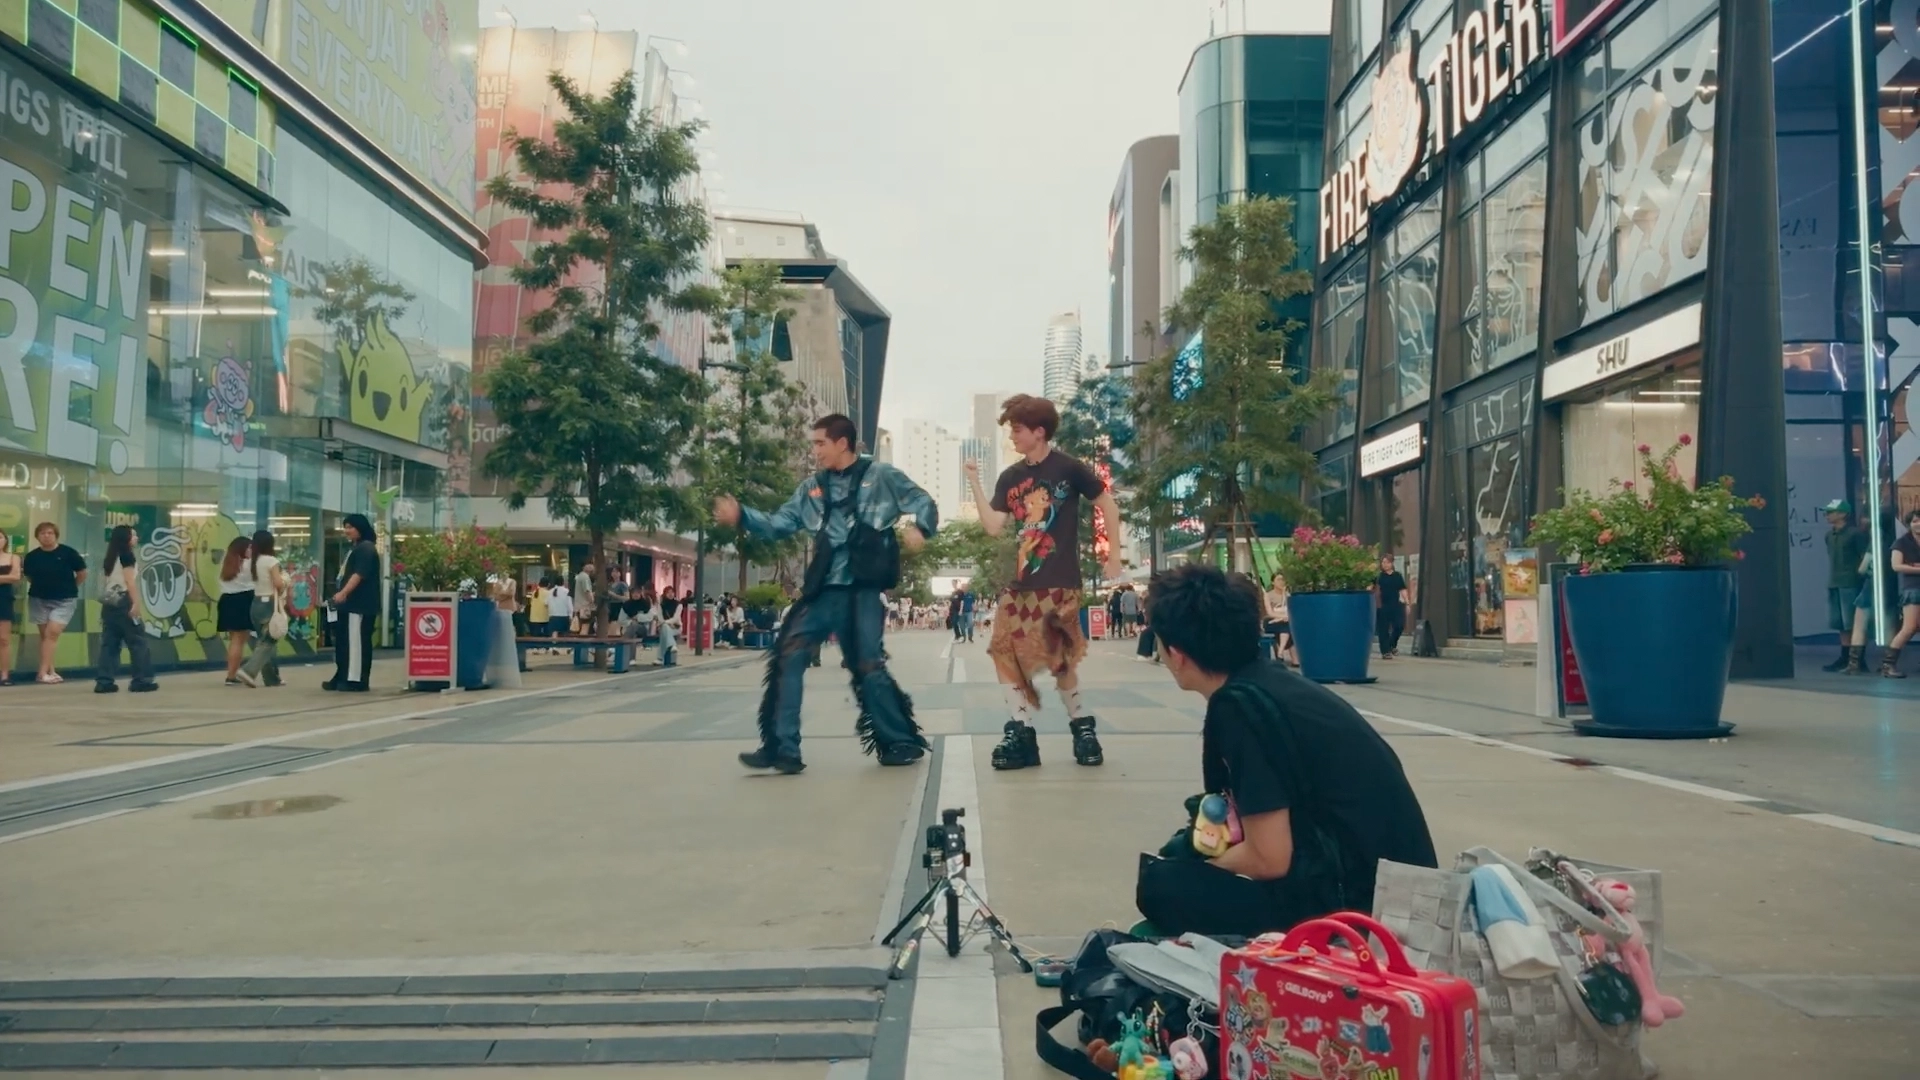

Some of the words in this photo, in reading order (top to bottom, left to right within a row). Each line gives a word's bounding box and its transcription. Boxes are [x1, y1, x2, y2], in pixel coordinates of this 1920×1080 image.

[59, 99, 128, 180] WILL
[1320, 140, 1371, 264] FIRE
[1429, 0, 1539, 154] TIGER
[283, 249, 325, 297] AIS
[1597, 338, 1630, 374] SHU
[1395, 433, 1419, 456] COFFEE
[1285, 982, 1327, 1003] GELBOYS
